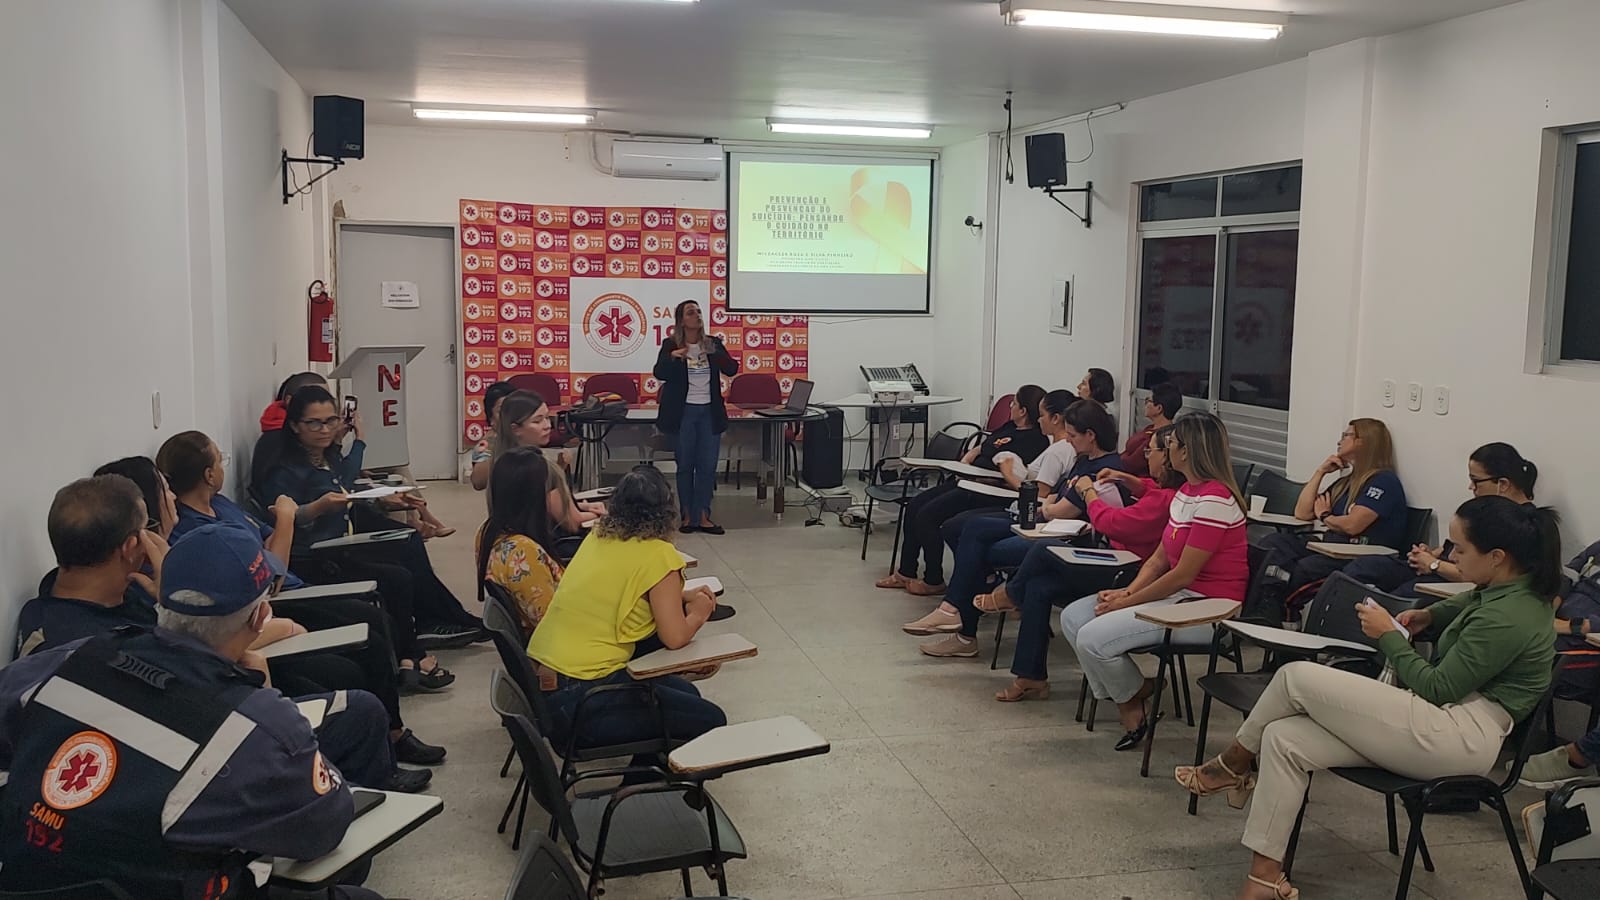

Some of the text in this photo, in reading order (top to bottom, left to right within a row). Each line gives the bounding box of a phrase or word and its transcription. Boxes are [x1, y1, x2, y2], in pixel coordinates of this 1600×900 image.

[661, 218, 673, 226] 192
[800, 213, 844, 223] PENSANDO
[776, 222, 814, 231] CUIDADO
[818, 223, 829, 231] NO
[518, 237, 531, 245] 192
[590, 240, 603, 248] 192
[482, 260, 495, 268] 192
[518, 262, 531, 270] 192
[518, 286, 531, 294] 192
[554, 287, 568, 295] 192
[482, 309, 495, 317] 192
[519, 310, 532, 318] 192
[554, 311, 568, 319] 192
[554, 335, 568, 343] 192
[653, 325, 676, 346] 19
[729, 337, 741, 345] 192
[795, 337, 807, 345] 192
[377, 363, 401, 392] N
[382, 399, 398, 427] E
[29, 802, 65, 830] SAMU
[25, 818, 64, 853] 192
